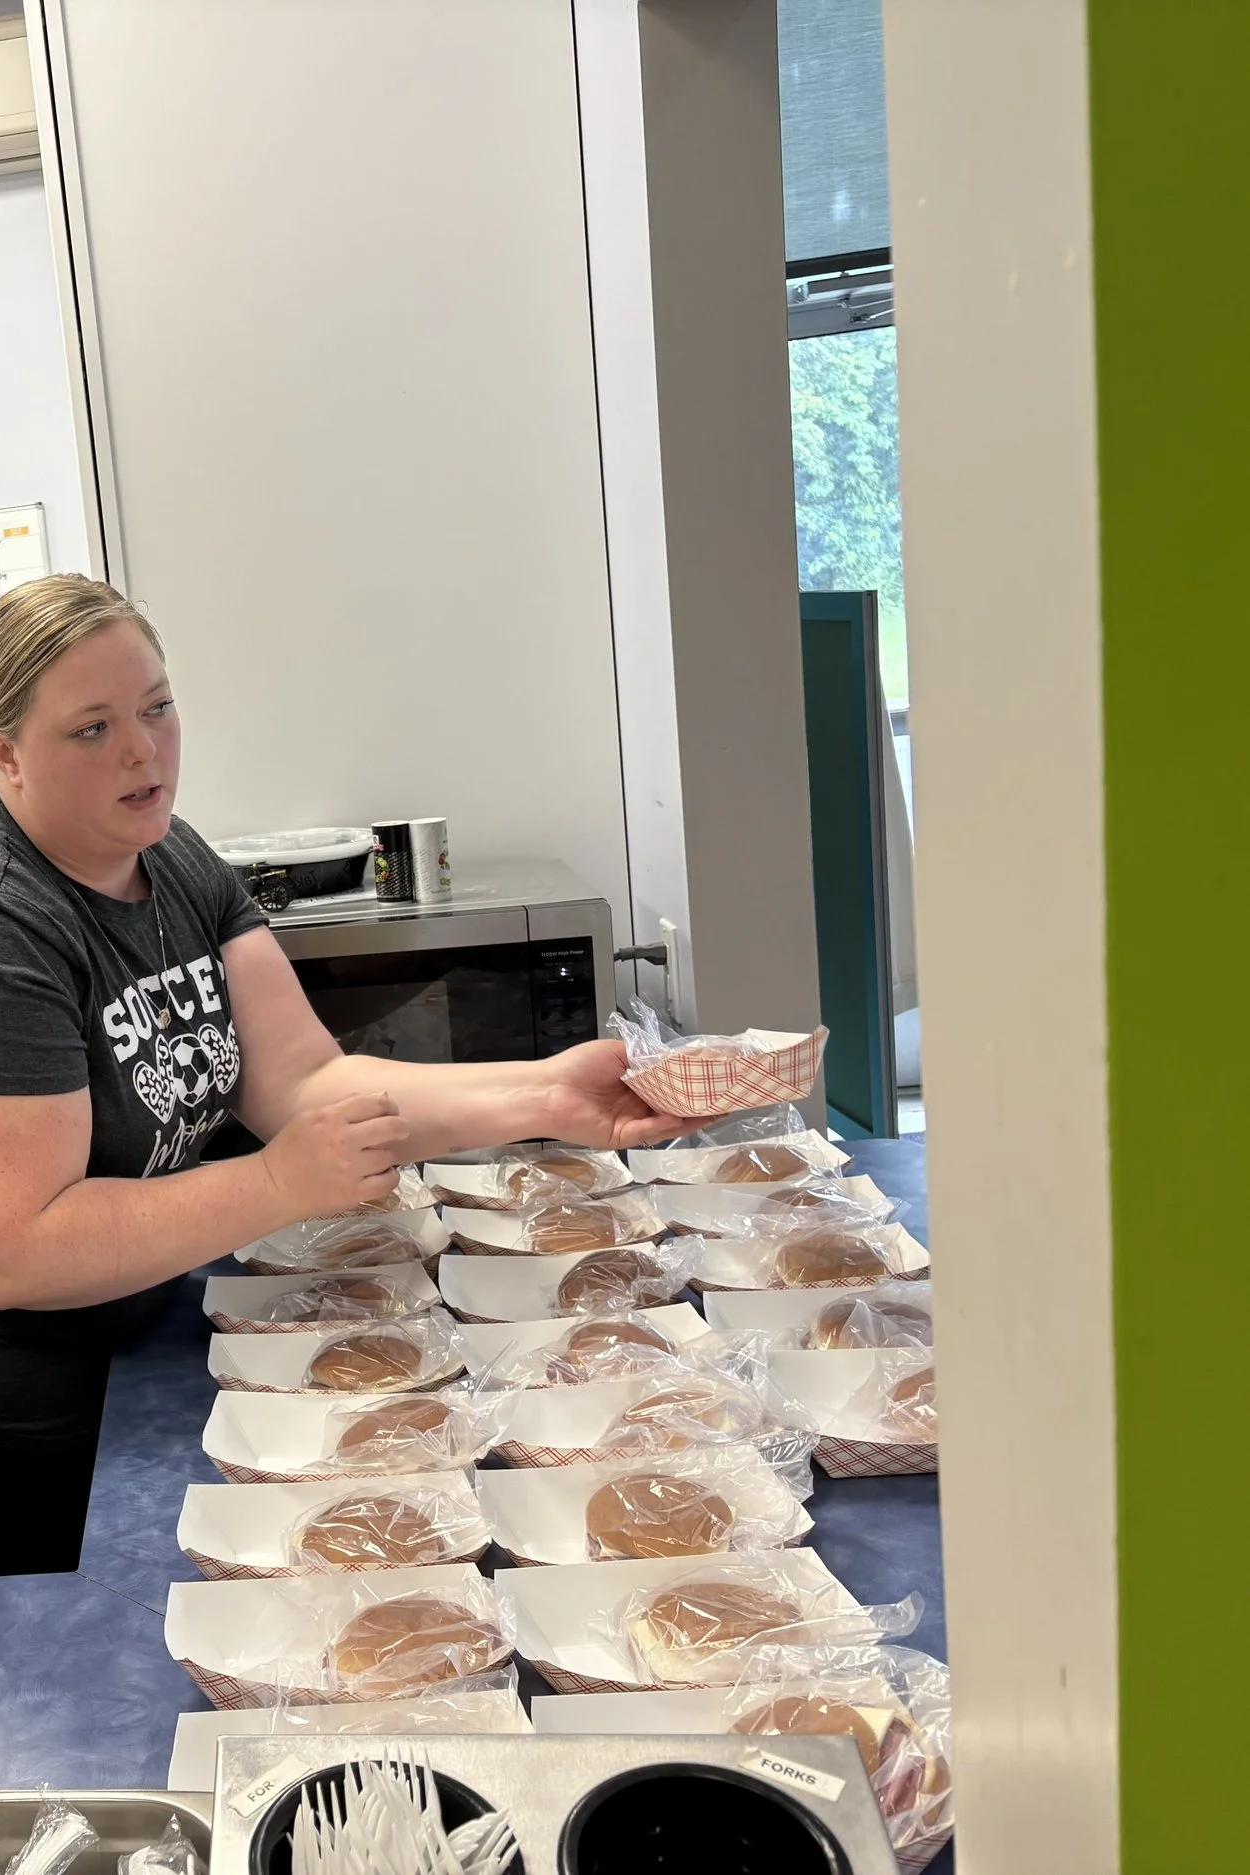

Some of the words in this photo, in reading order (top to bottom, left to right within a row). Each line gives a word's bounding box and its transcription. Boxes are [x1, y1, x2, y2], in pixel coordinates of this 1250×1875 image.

[103, 954, 226, 1064] SOCCE
[761, 1758, 817, 1785] FORKS
[247, 1780, 274, 1802] FOR
